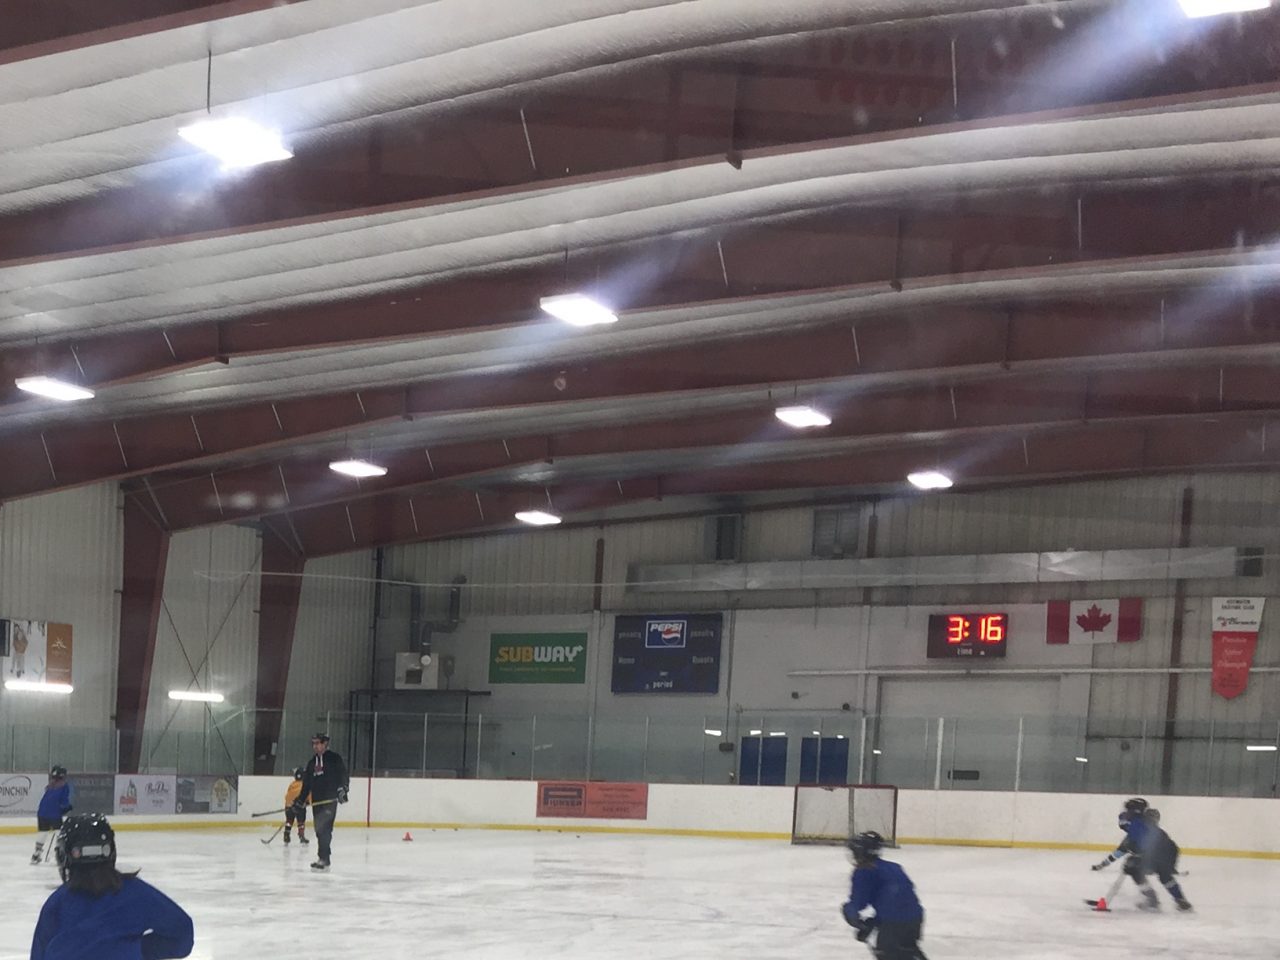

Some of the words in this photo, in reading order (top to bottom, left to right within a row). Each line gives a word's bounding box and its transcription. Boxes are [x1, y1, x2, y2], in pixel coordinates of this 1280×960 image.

[649, 623, 683, 632] PEPSI
[948, 616, 1003, 642] 3:16
[495, 645, 584, 664] SUBWAY
